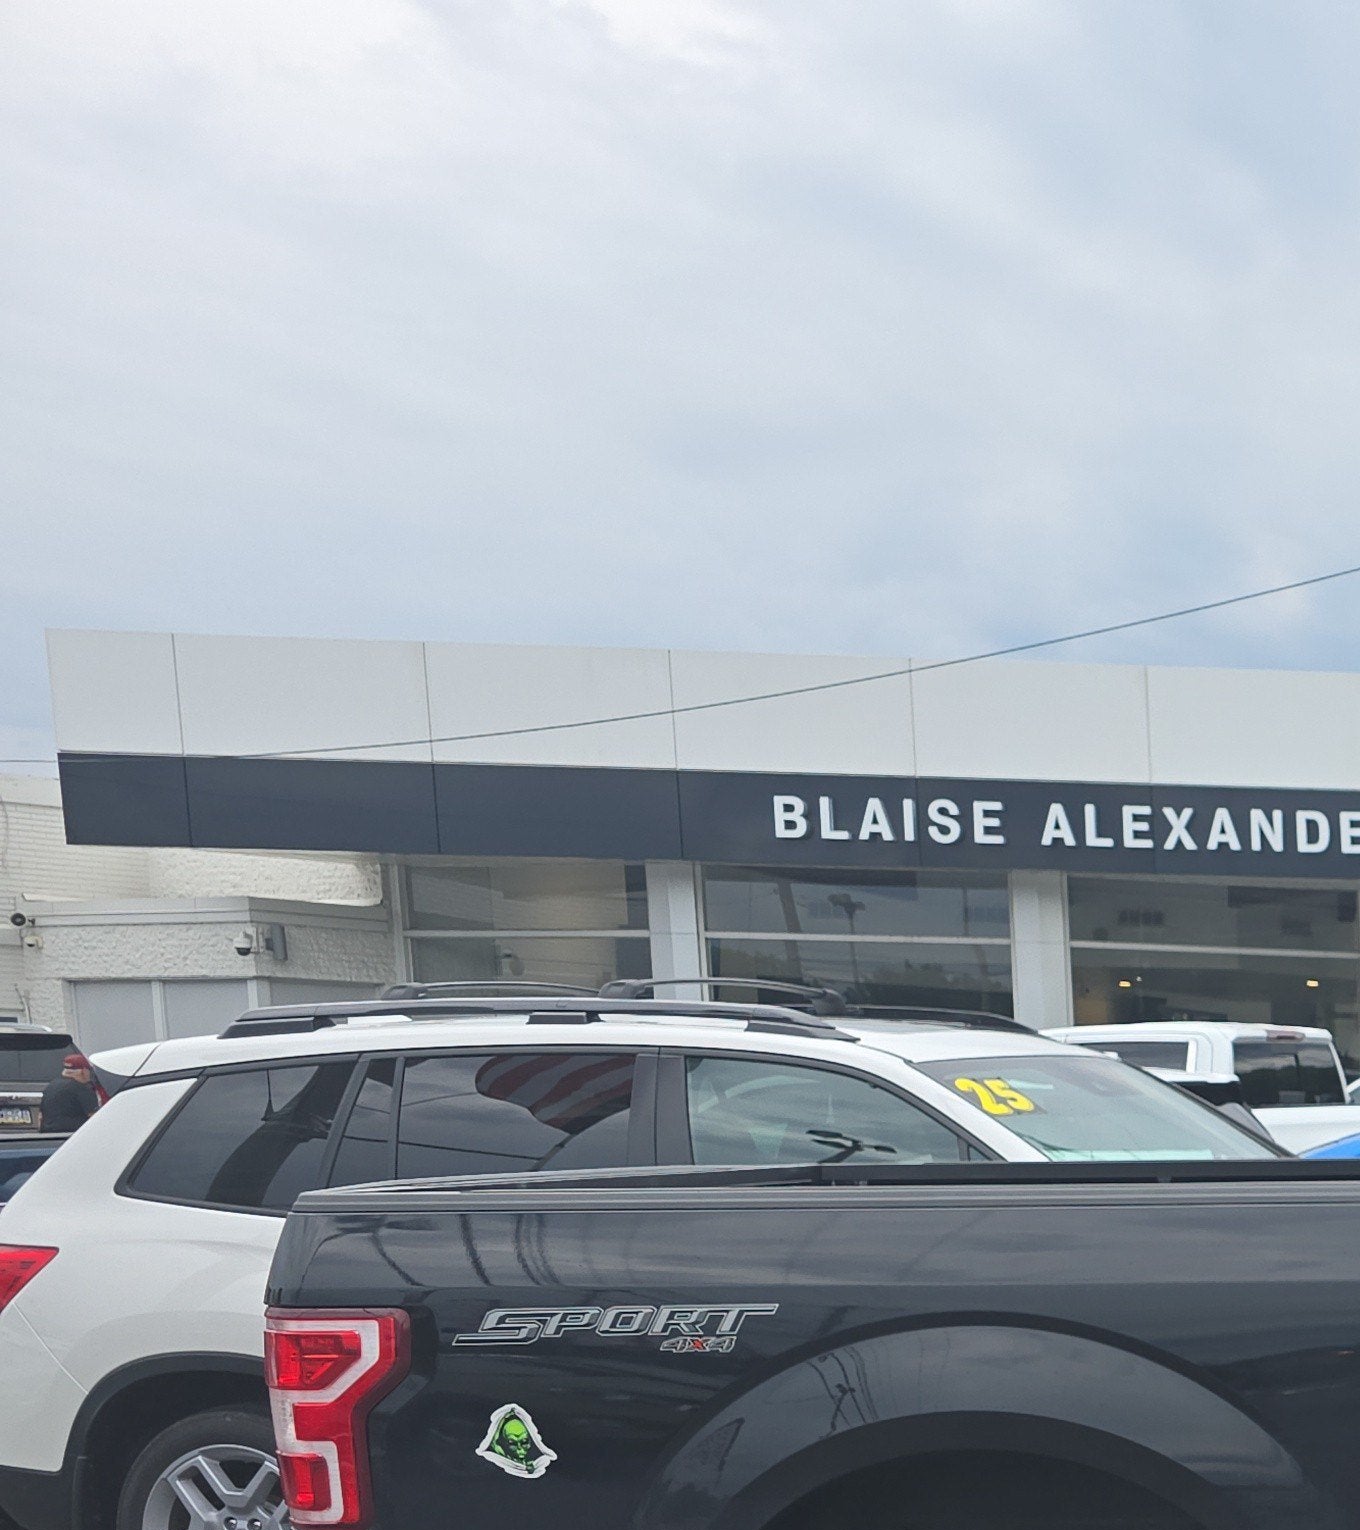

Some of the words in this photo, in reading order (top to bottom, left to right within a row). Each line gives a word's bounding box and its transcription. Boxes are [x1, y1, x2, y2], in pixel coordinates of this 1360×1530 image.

[773, 795, 1006, 844] BLAISE
[954, 1077, 1035, 1116] 25
[452, 1303, 779, 1346] SPORT
